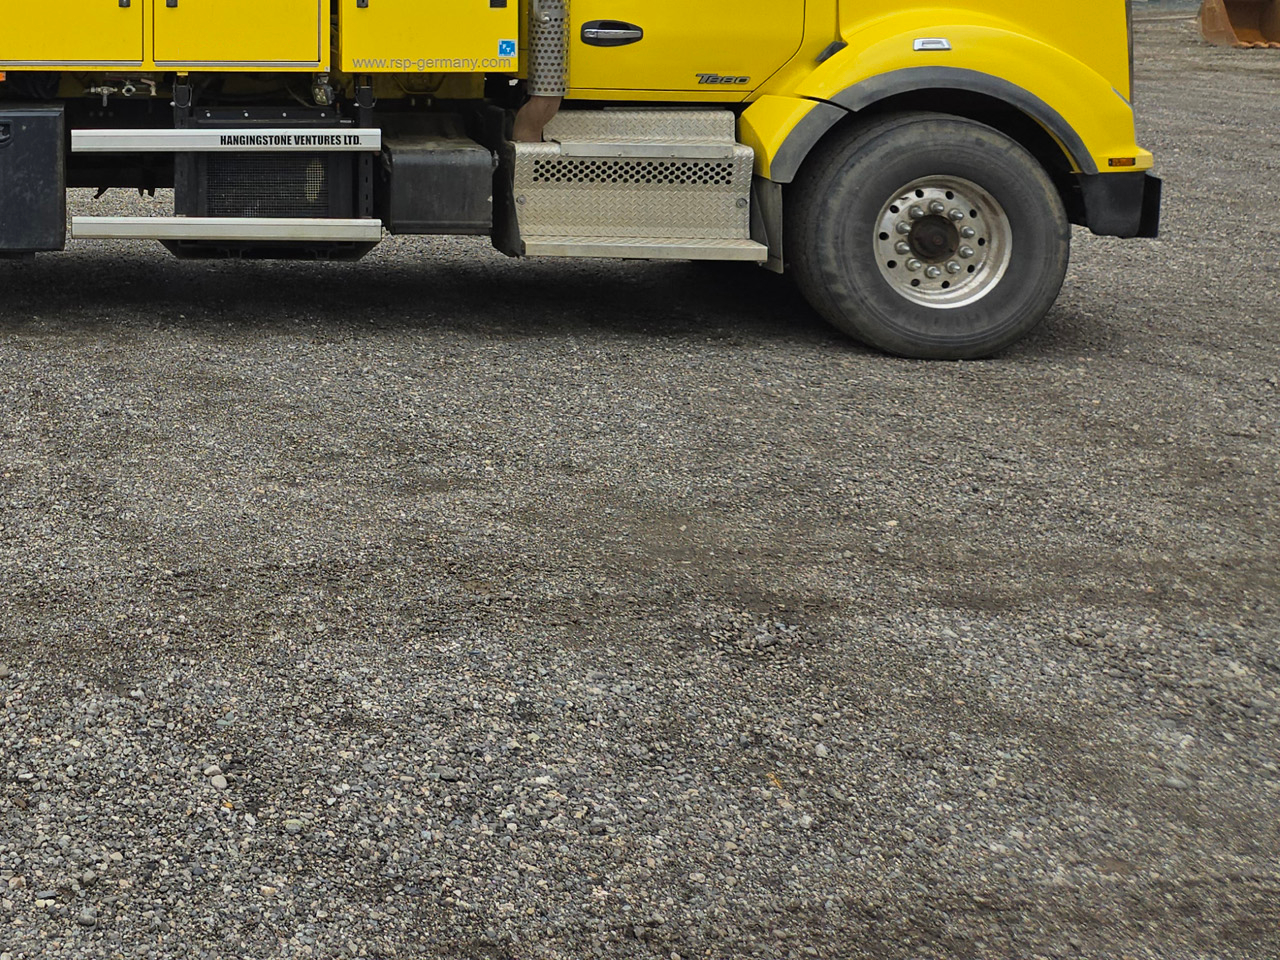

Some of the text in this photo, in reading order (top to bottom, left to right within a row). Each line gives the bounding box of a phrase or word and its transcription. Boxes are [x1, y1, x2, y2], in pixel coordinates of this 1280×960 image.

[352, 57, 511, 71] www.rsp-germany.com
[220, 135, 362, 146] HANGINGSTONE VENTURES LTD.
